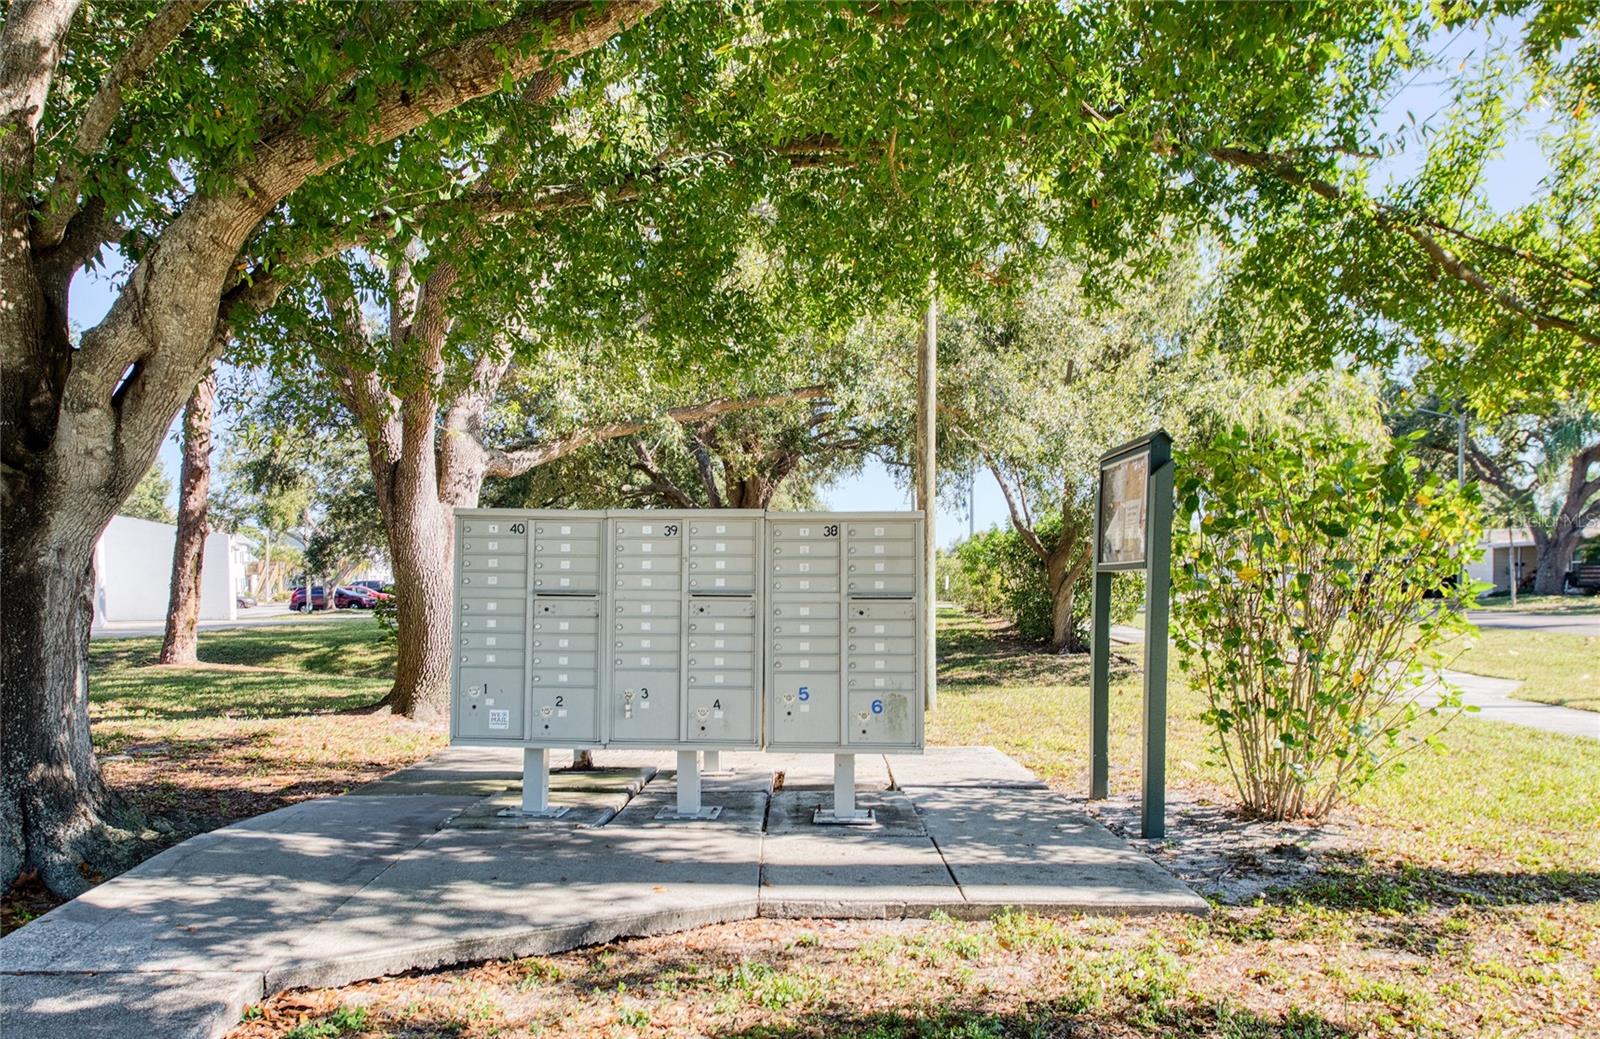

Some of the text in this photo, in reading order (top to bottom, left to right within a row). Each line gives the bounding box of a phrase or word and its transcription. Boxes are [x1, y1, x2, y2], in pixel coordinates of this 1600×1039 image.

[509, 523, 526, 535] 40
[664, 525, 678, 536] 39
[823, 525, 838, 537] 38
[483, 683, 488, 694] 1
[640, 688, 649, 699] 3
[798, 686, 810, 701] 5
[555, 696, 564, 707] 2
[713, 699, 721, 710] 4
[871, 699, 883, 714] 6
